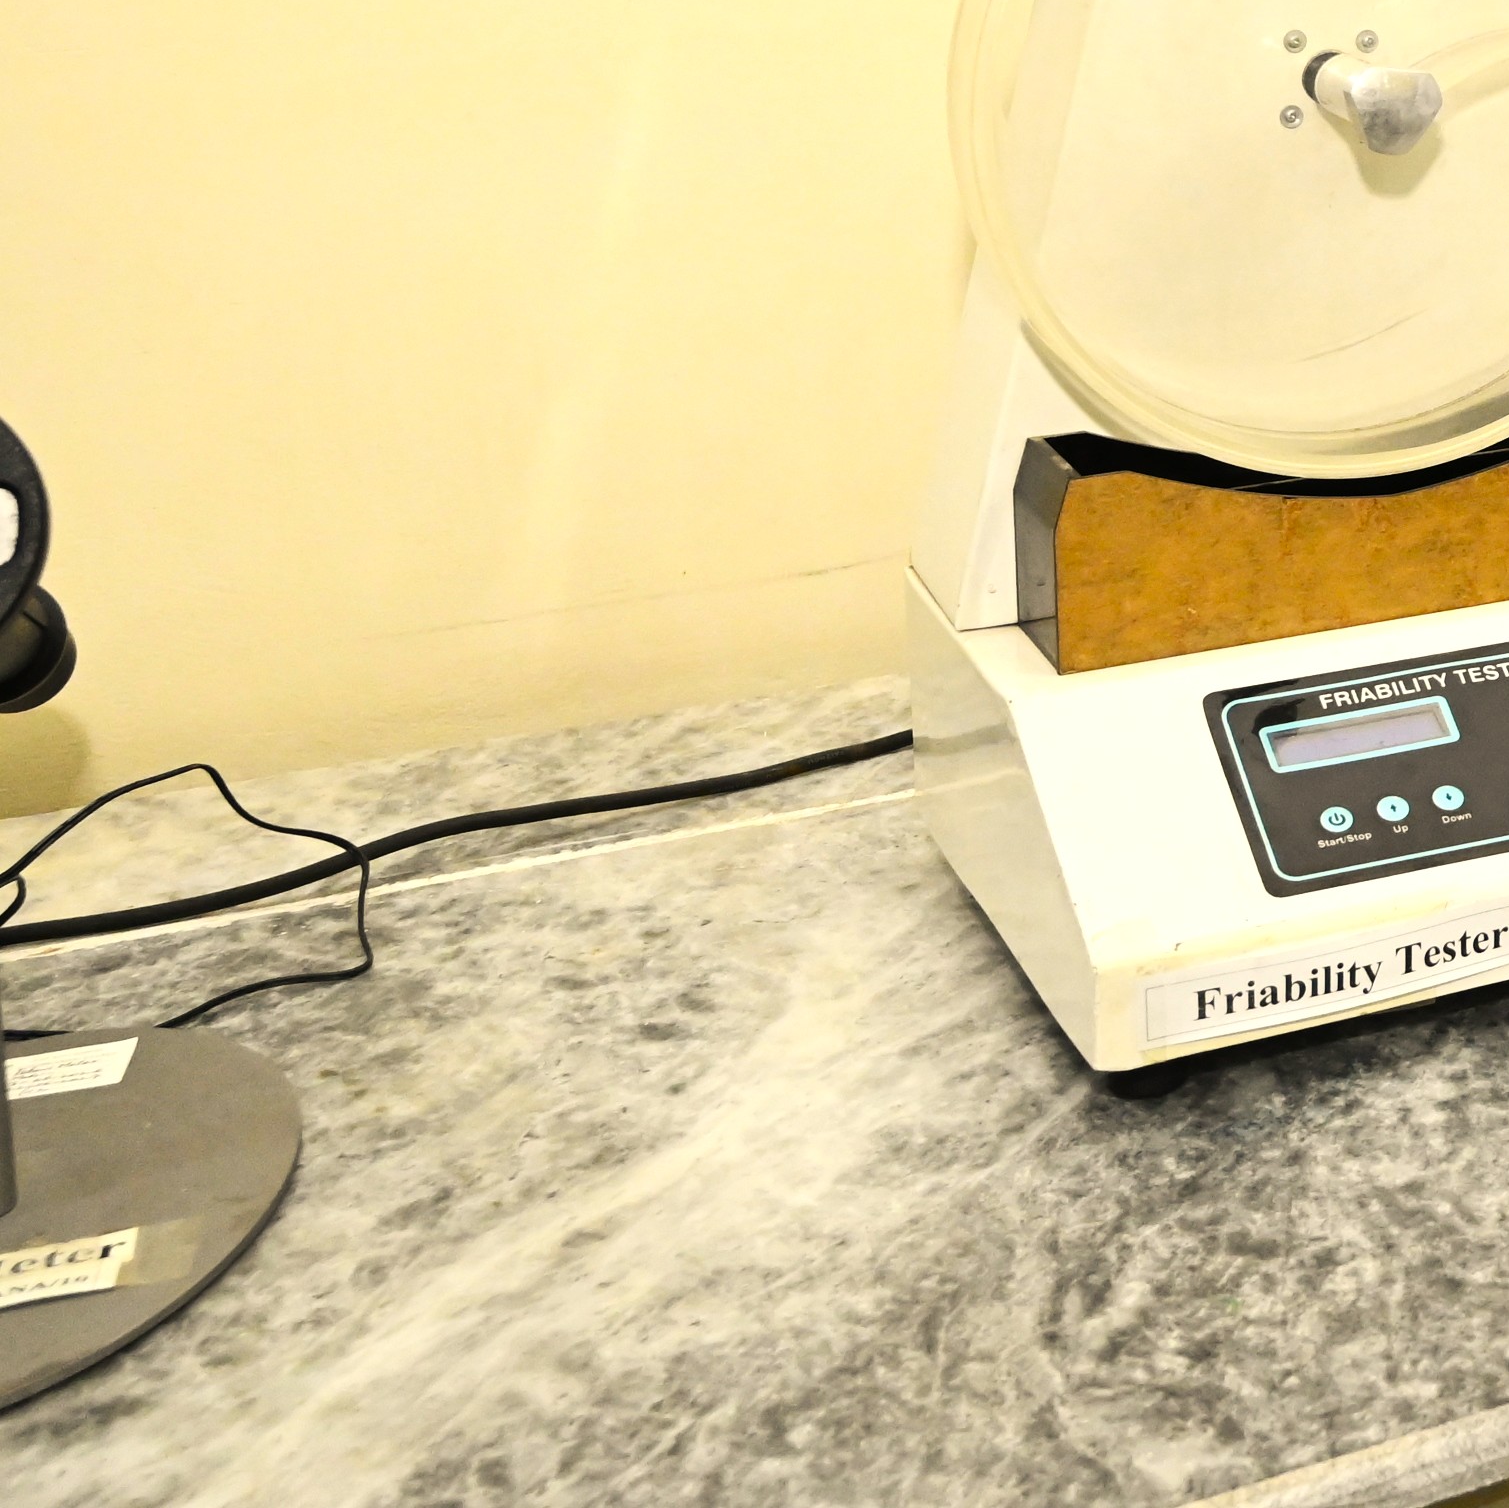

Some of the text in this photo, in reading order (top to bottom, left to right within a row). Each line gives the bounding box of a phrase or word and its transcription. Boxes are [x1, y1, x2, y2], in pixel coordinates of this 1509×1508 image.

[1319, 673, 1448, 710] FRIABILITY
[1392, 823, 1409, 835] Up
[1441, 811, 1472, 825] Down
[1317, 830, 1372, 849] Start/Stop
[1194, 922, 1509, 1023] Friability Tester
[0, 1239, 127, 1274] eter
